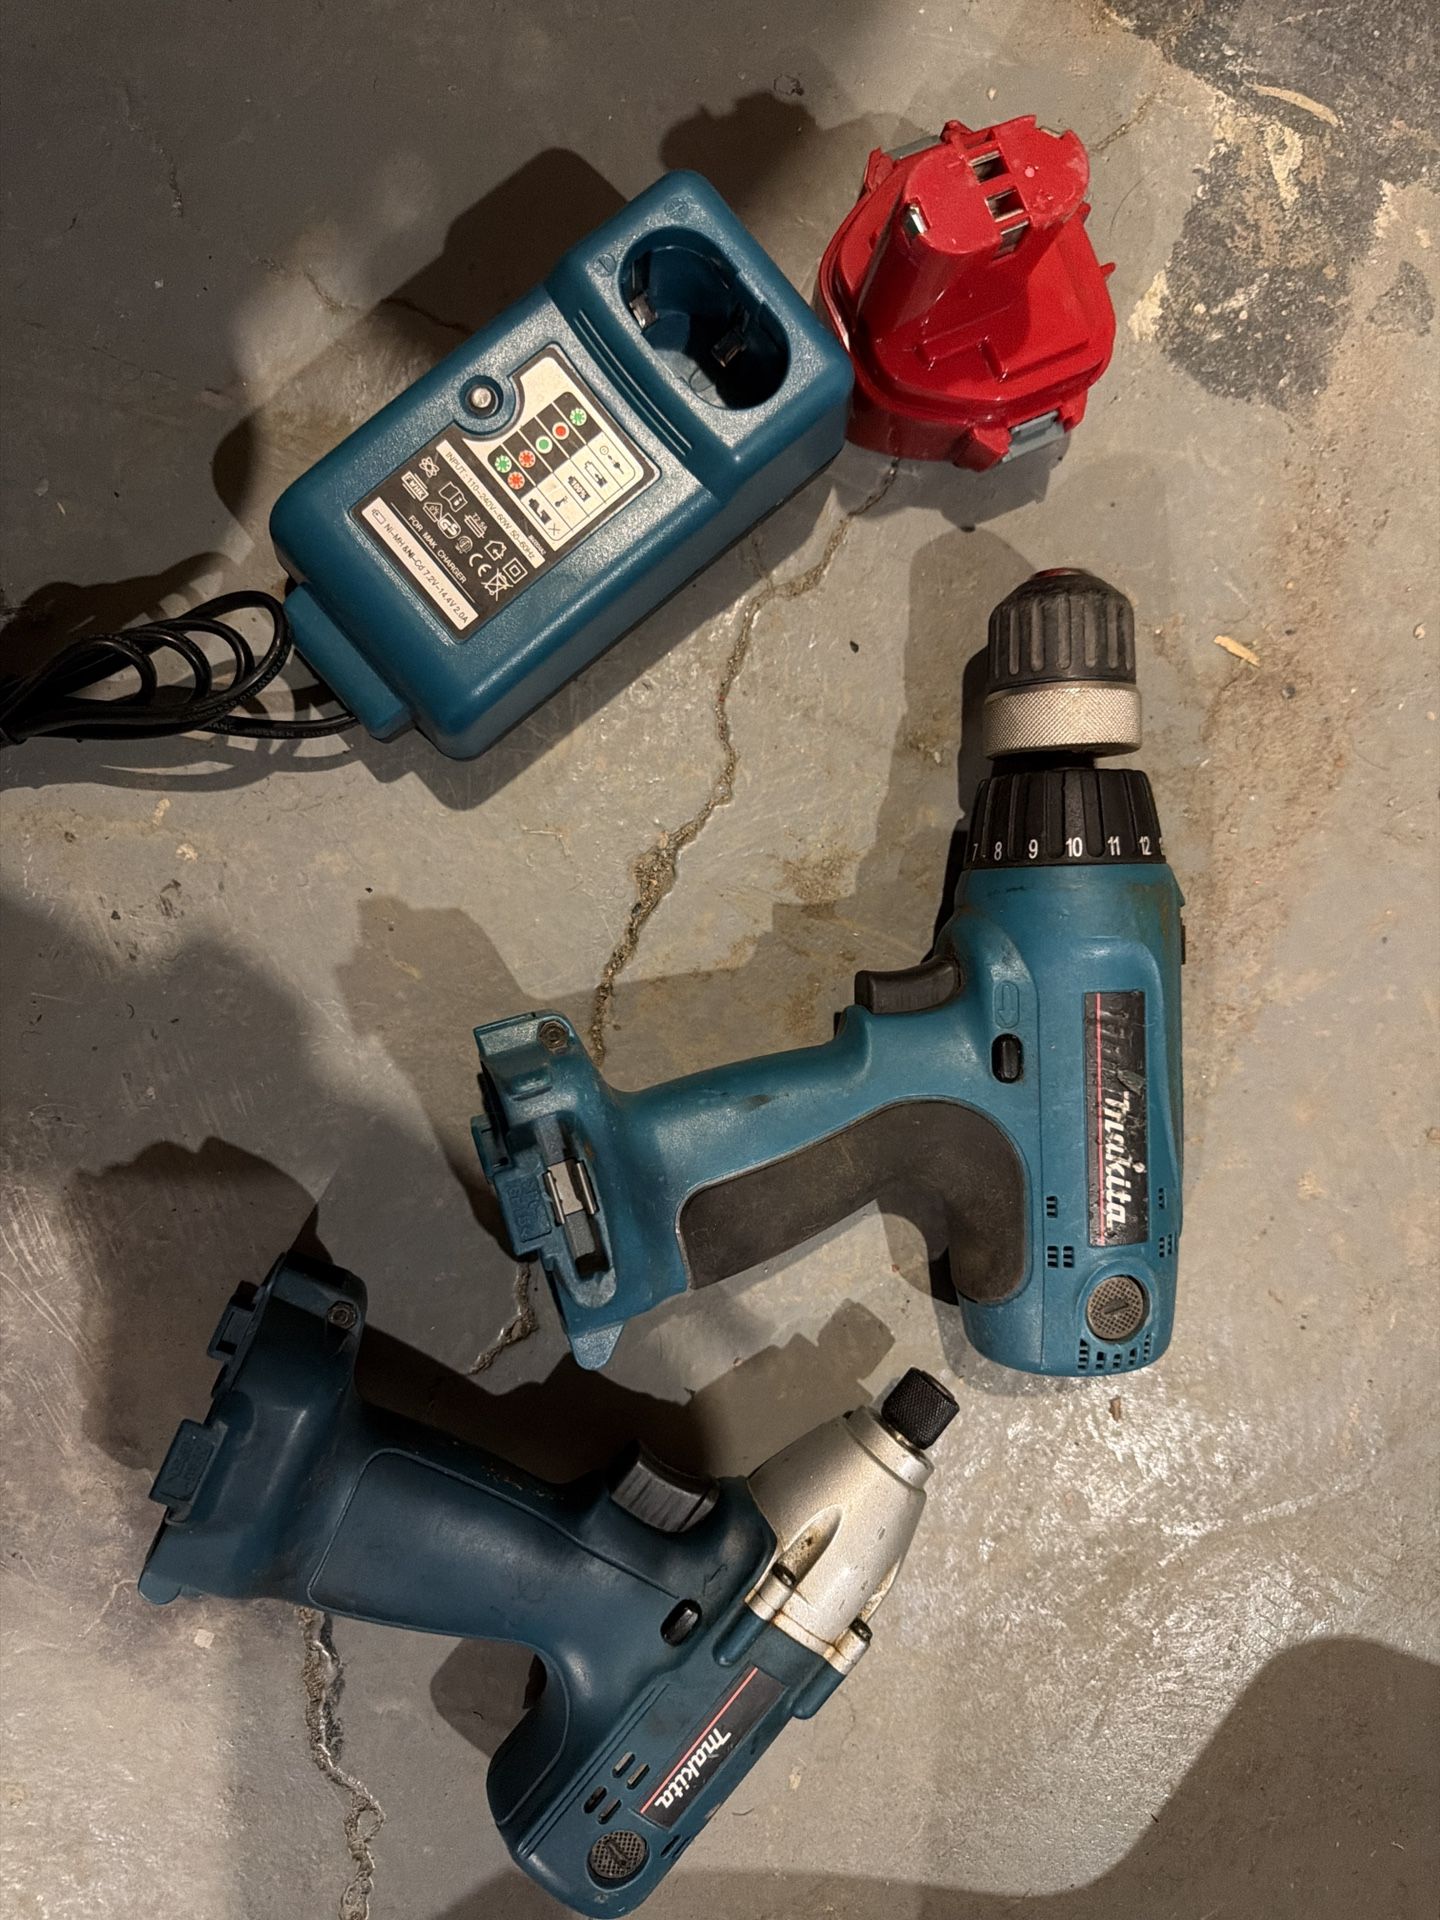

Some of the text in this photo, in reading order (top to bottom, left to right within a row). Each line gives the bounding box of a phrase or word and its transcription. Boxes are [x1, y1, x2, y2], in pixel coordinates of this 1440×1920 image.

[571, 477, 590, 498] 100%
[440, 519, 460, 538] GS
[409, 515, 423, 531] FOR
[422, 532, 437, 548] MAK
[437, 549, 466, 583] CHARGER
[469, 553, 491, 577] CE
[453, 606, 468, 623] 2.0A
[994, 841, 1002, 860] 8
[1028, 840, 1038, 858] 9
[1066, 837, 1083, 857] 10
[1108, 836, 1120, 855] 11
[1139, 836, 1152, 855] 12
